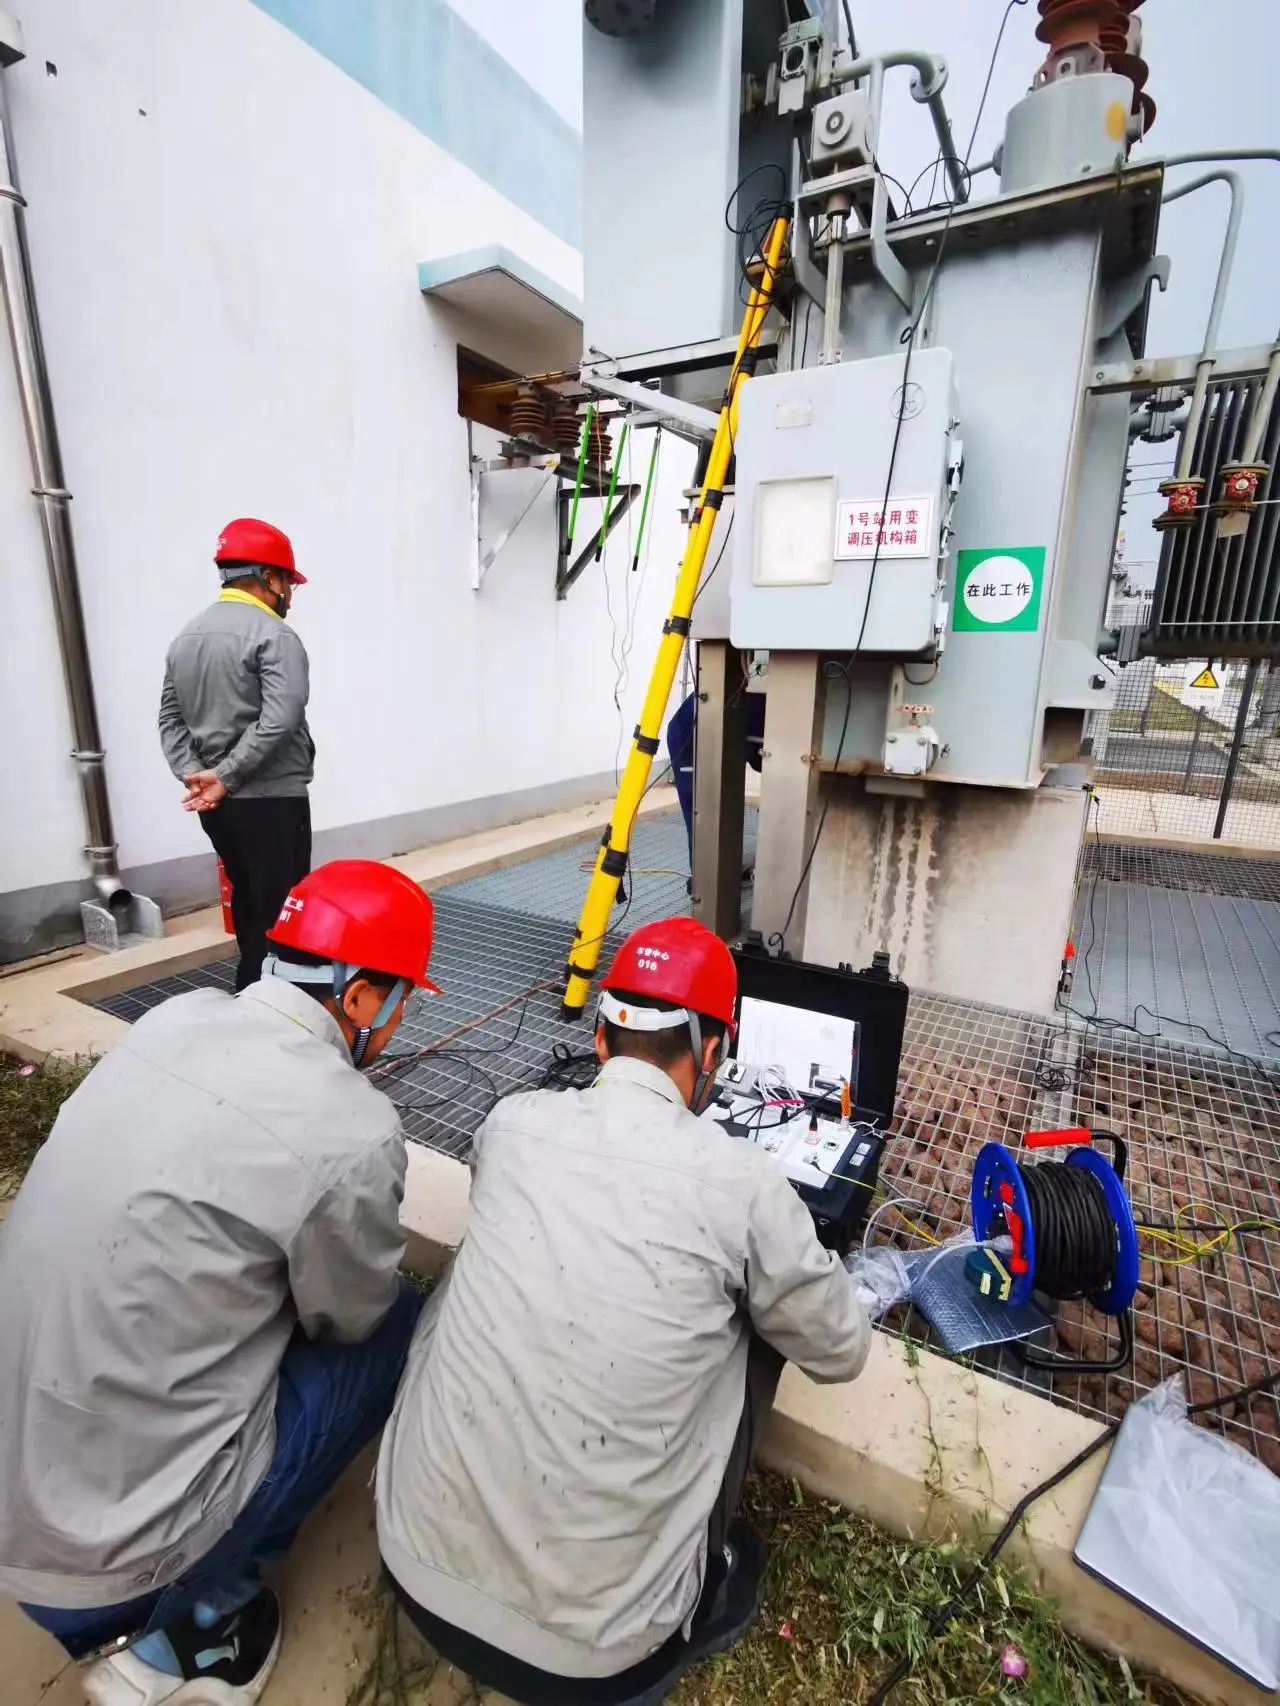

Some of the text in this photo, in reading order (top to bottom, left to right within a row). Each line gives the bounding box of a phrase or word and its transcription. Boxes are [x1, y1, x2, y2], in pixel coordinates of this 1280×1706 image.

[848, 508, 919, 527] 1号站用变
[847, 530, 918, 547] 调压机构箱
[966, 582, 1031, 598] 在此工作
